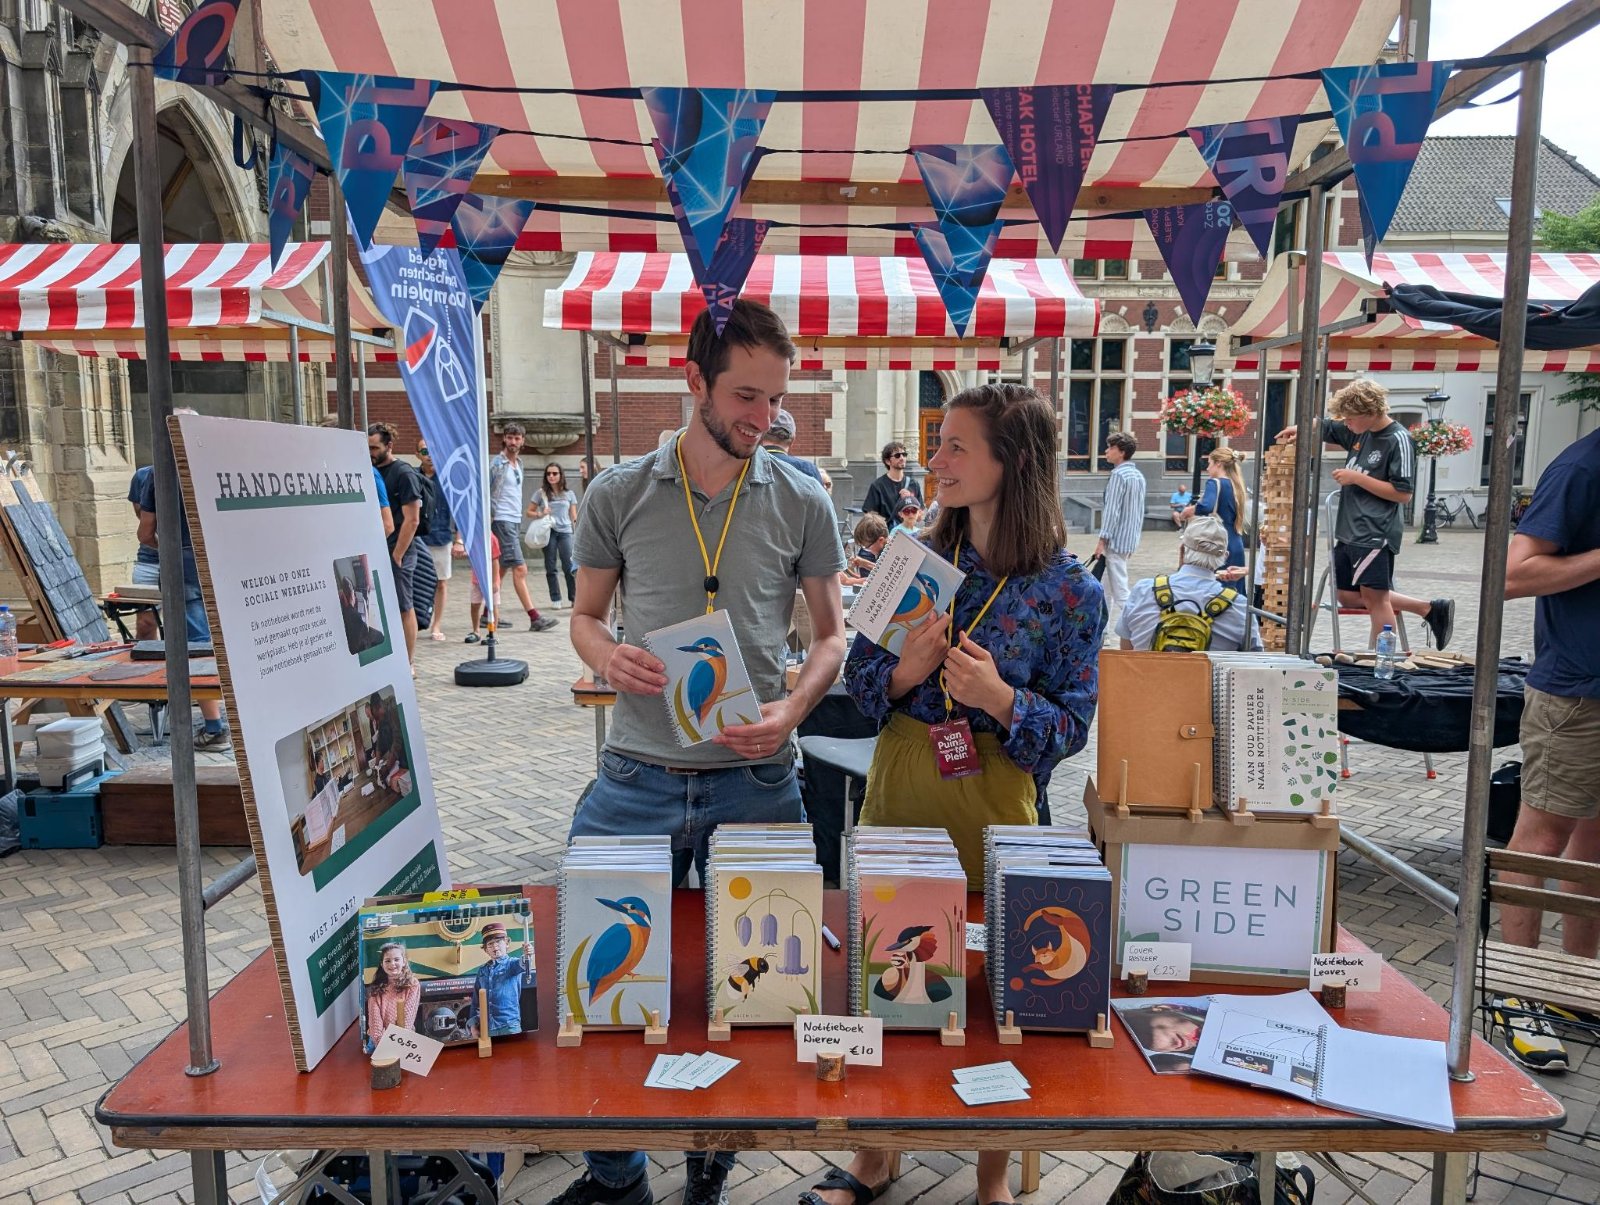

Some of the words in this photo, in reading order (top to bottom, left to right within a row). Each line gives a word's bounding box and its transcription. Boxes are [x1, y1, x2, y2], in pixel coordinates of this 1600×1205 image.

[1020, 124, 1037, 188] HOTEL
[1164, 210, 1172, 243] SLEEPY
[216, 472, 364, 498] HANDGEMAAKT
[241, 575, 277, 590] WELKOM
[279, 572, 289, 583] OP
[291, 567, 311, 581] ONZE
[865, 597, 877, 614] VAN
[876, 580, 888, 599] OUD
[884, 555, 901, 581] PAPIER
[869, 601, 884, 624] NAAR
[881, 556, 910, 605] NOTITIEBOEK
[244, 590, 280, 607] SOCIALE
[282, 579, 327, 600] WERKPLAATS
[1247, 694, 1255, 730] PAPIER
[1256, 688, 1265, 757] NOTITIEBOEK
[1247, 734, 1255, 757] OUD
[1247, 761, 1255, 783] VAN
[1256, 762, 1265, 790] NAAR
[1144, 876, 1297, 909] GREEN
[309, 922, 328, 944] WIST
[330, 912, 339, 926] JE
[1163, 907, 1267, 938] SIDE
[1313, 956, 1364, 967] Notitieboek
[1313, 968, 1346, 977] Leaves
[803, 1022, 864, 1034] Notitieboek
[803, 1034, 841, 1045] Dieren
[849, 1045, 874, 1056] €10
